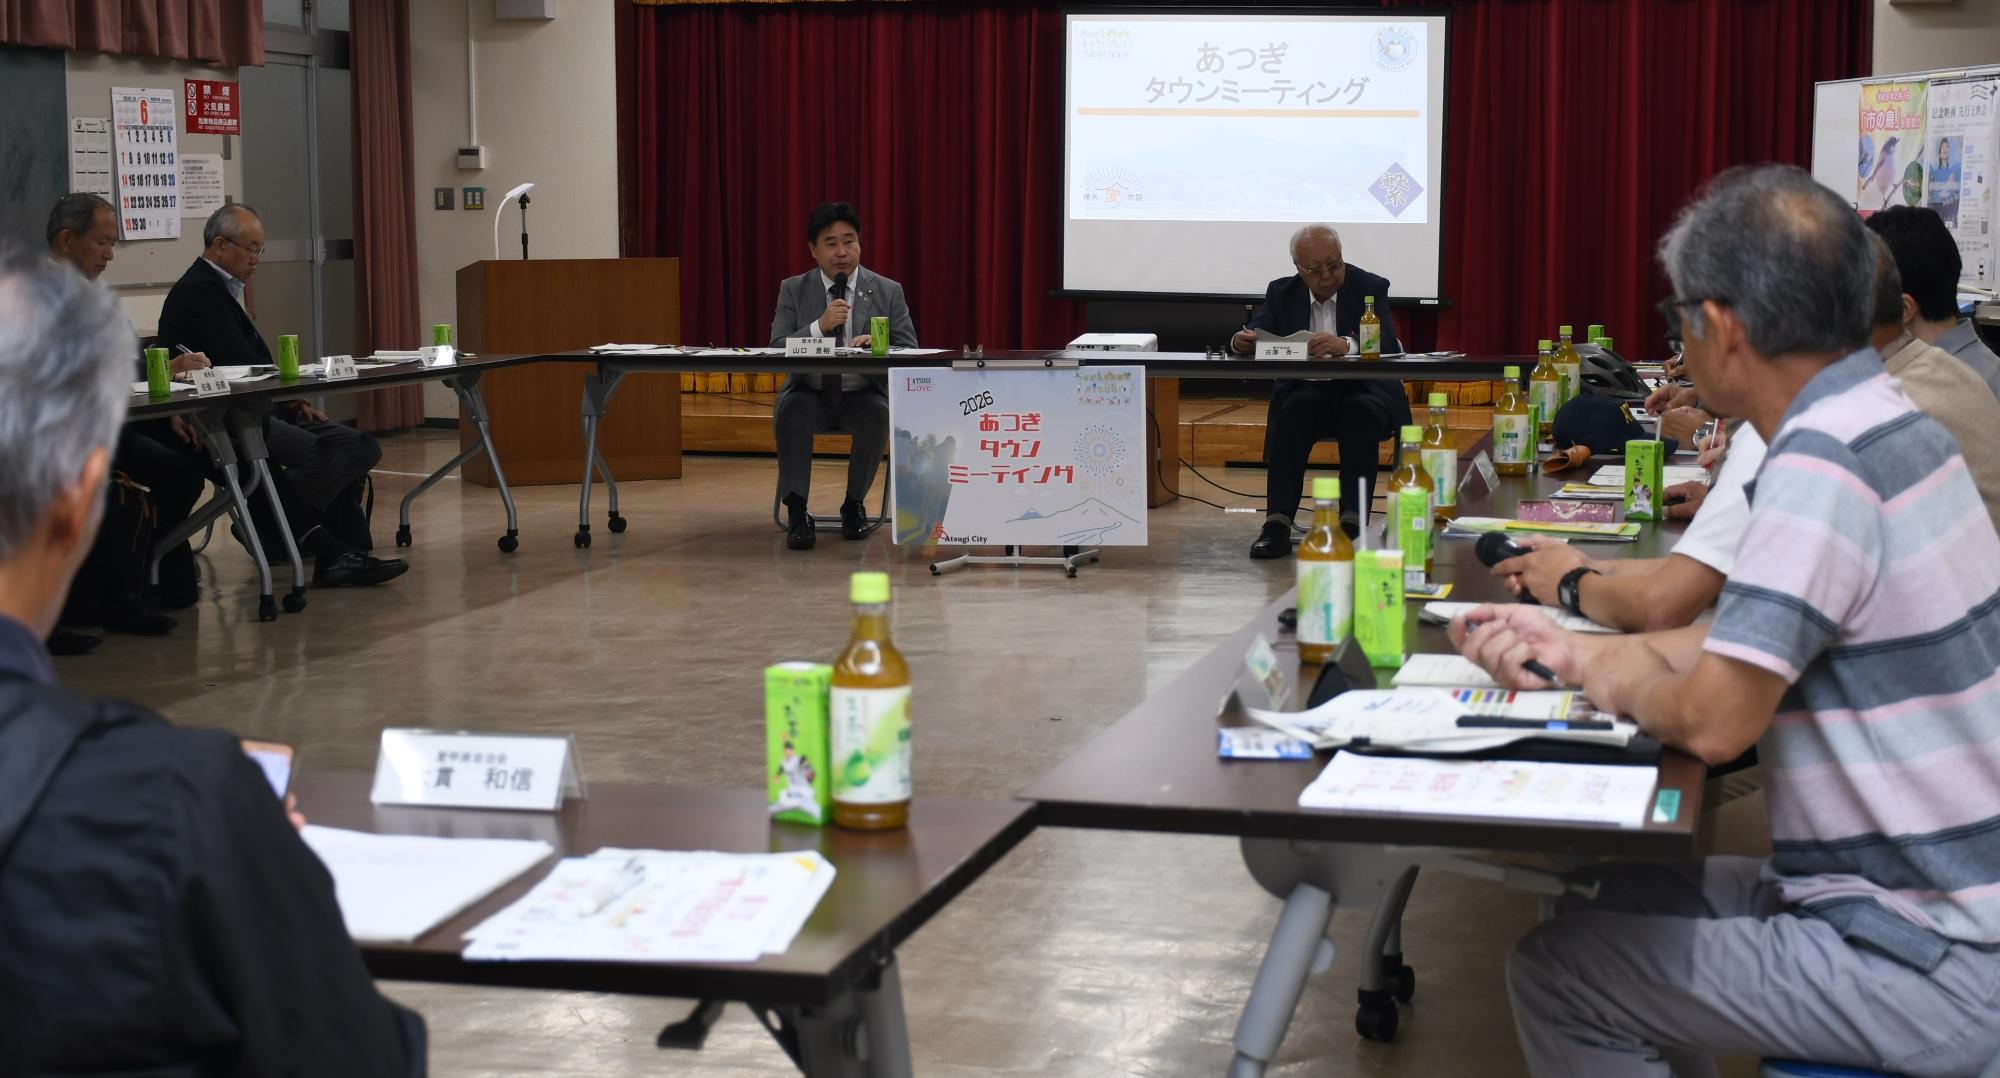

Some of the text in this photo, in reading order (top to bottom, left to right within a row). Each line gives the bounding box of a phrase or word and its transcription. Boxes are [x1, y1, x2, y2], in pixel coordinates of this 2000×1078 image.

[1196, 42, 1288, 74] あつぎ
[1145, 76, 1370, 105] タウンミーティング
[140, 99, 148, 125] 6
[127, 130, 172, 143] 1 2 3 4 5 6
[121, 152, 174, 165] 7 8 9 10 11 12 13
[121, 174, 176, 187] 14 15 16 17 18 19 20
[123, 195, 176, 209] 21 22 23 24 25 26 27
[125, 217, 147, 231] 28 29 30
[960, 391, 994, 415] 2026
[979, 413, 1041, 431] あつぎ
[980, 440, 1041, 457] タウン
[949, 465, 1074, 484] ミーティング
[945, 535, 987, 544] Atsugi City
[483, 766, 535, 792] 和信
